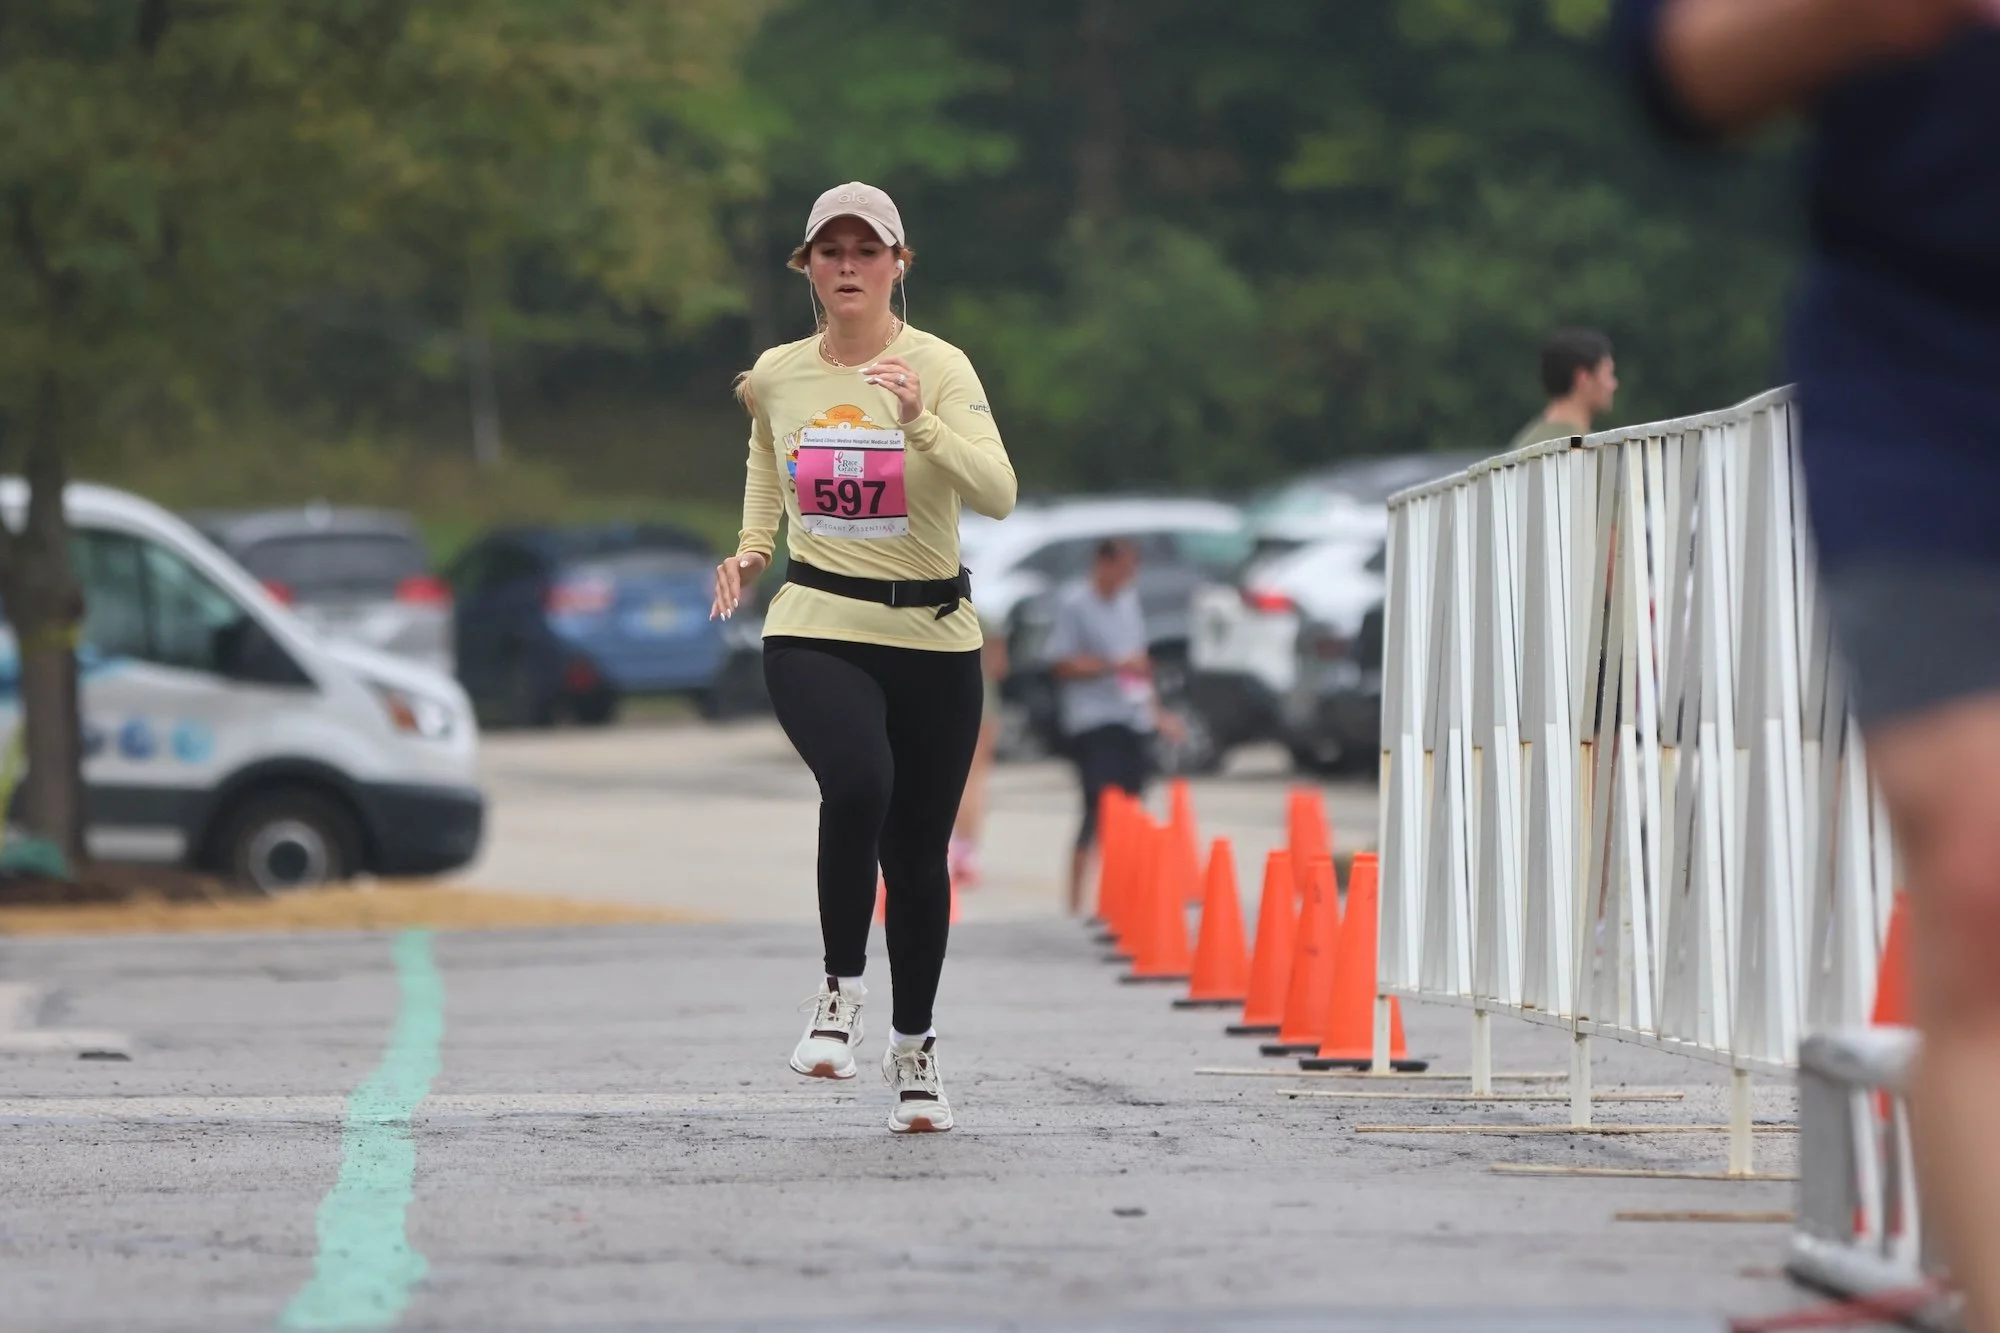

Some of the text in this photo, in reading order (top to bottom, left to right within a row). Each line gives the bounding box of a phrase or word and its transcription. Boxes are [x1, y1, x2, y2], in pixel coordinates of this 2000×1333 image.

[838, 191, 868, 204] alo
[837, 464, 858, 472] Grace
[842, 459, 858, 467] Race
[814, 479, 886, 515] 597
